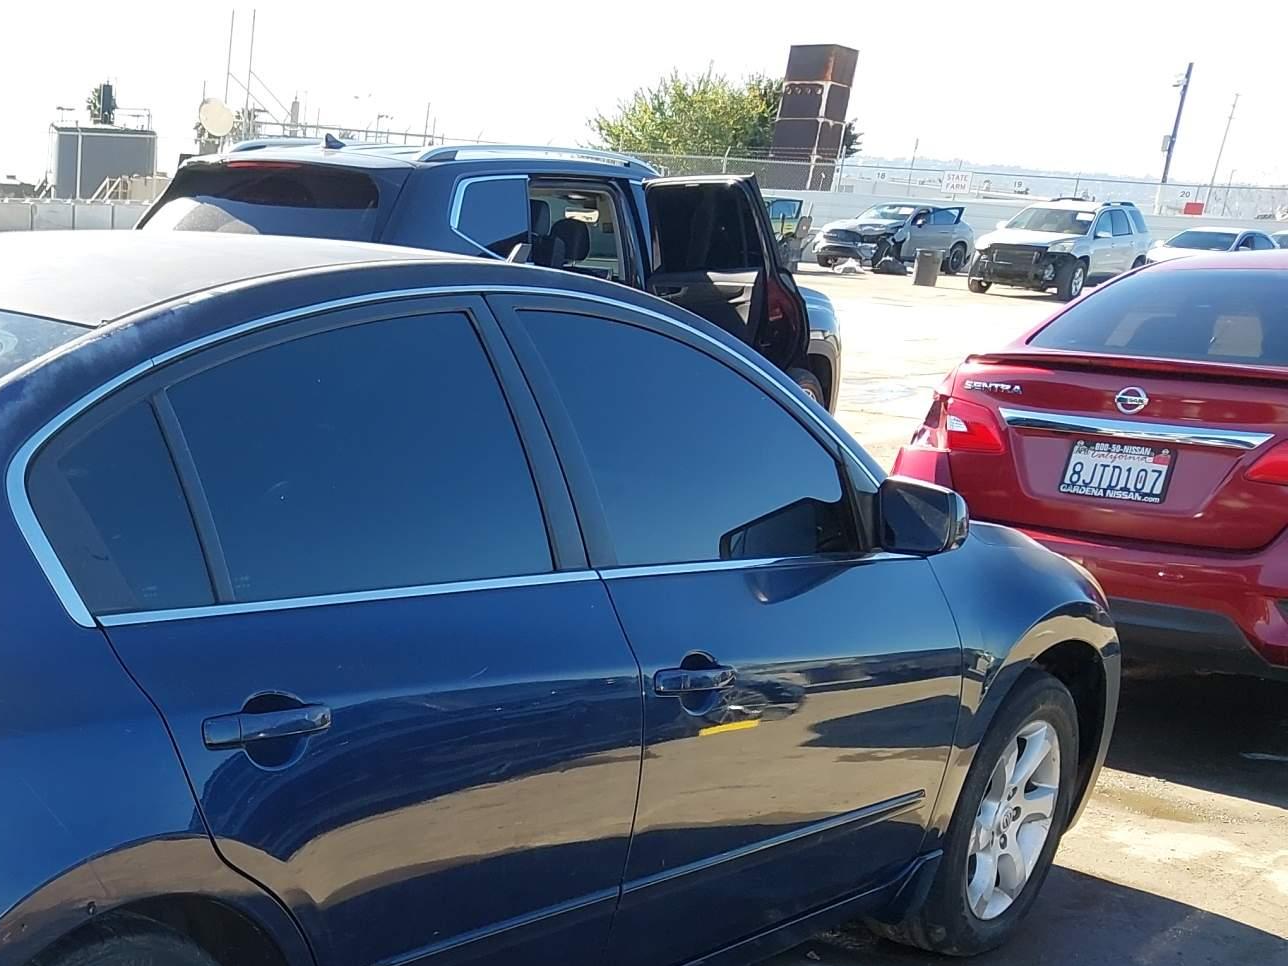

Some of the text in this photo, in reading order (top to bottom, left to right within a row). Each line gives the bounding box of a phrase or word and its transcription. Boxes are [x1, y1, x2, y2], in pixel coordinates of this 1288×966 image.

[946, 173, 968, 182] STATE
[945, 182, 967, 190] FARM
[1179, 190, 1191, 198] 20
[963, 379, 1023, 395] SENTRA
[1068, 460, 1164, 494] 8JTD107
[1059, 484, 1104, 498] GARDENA
